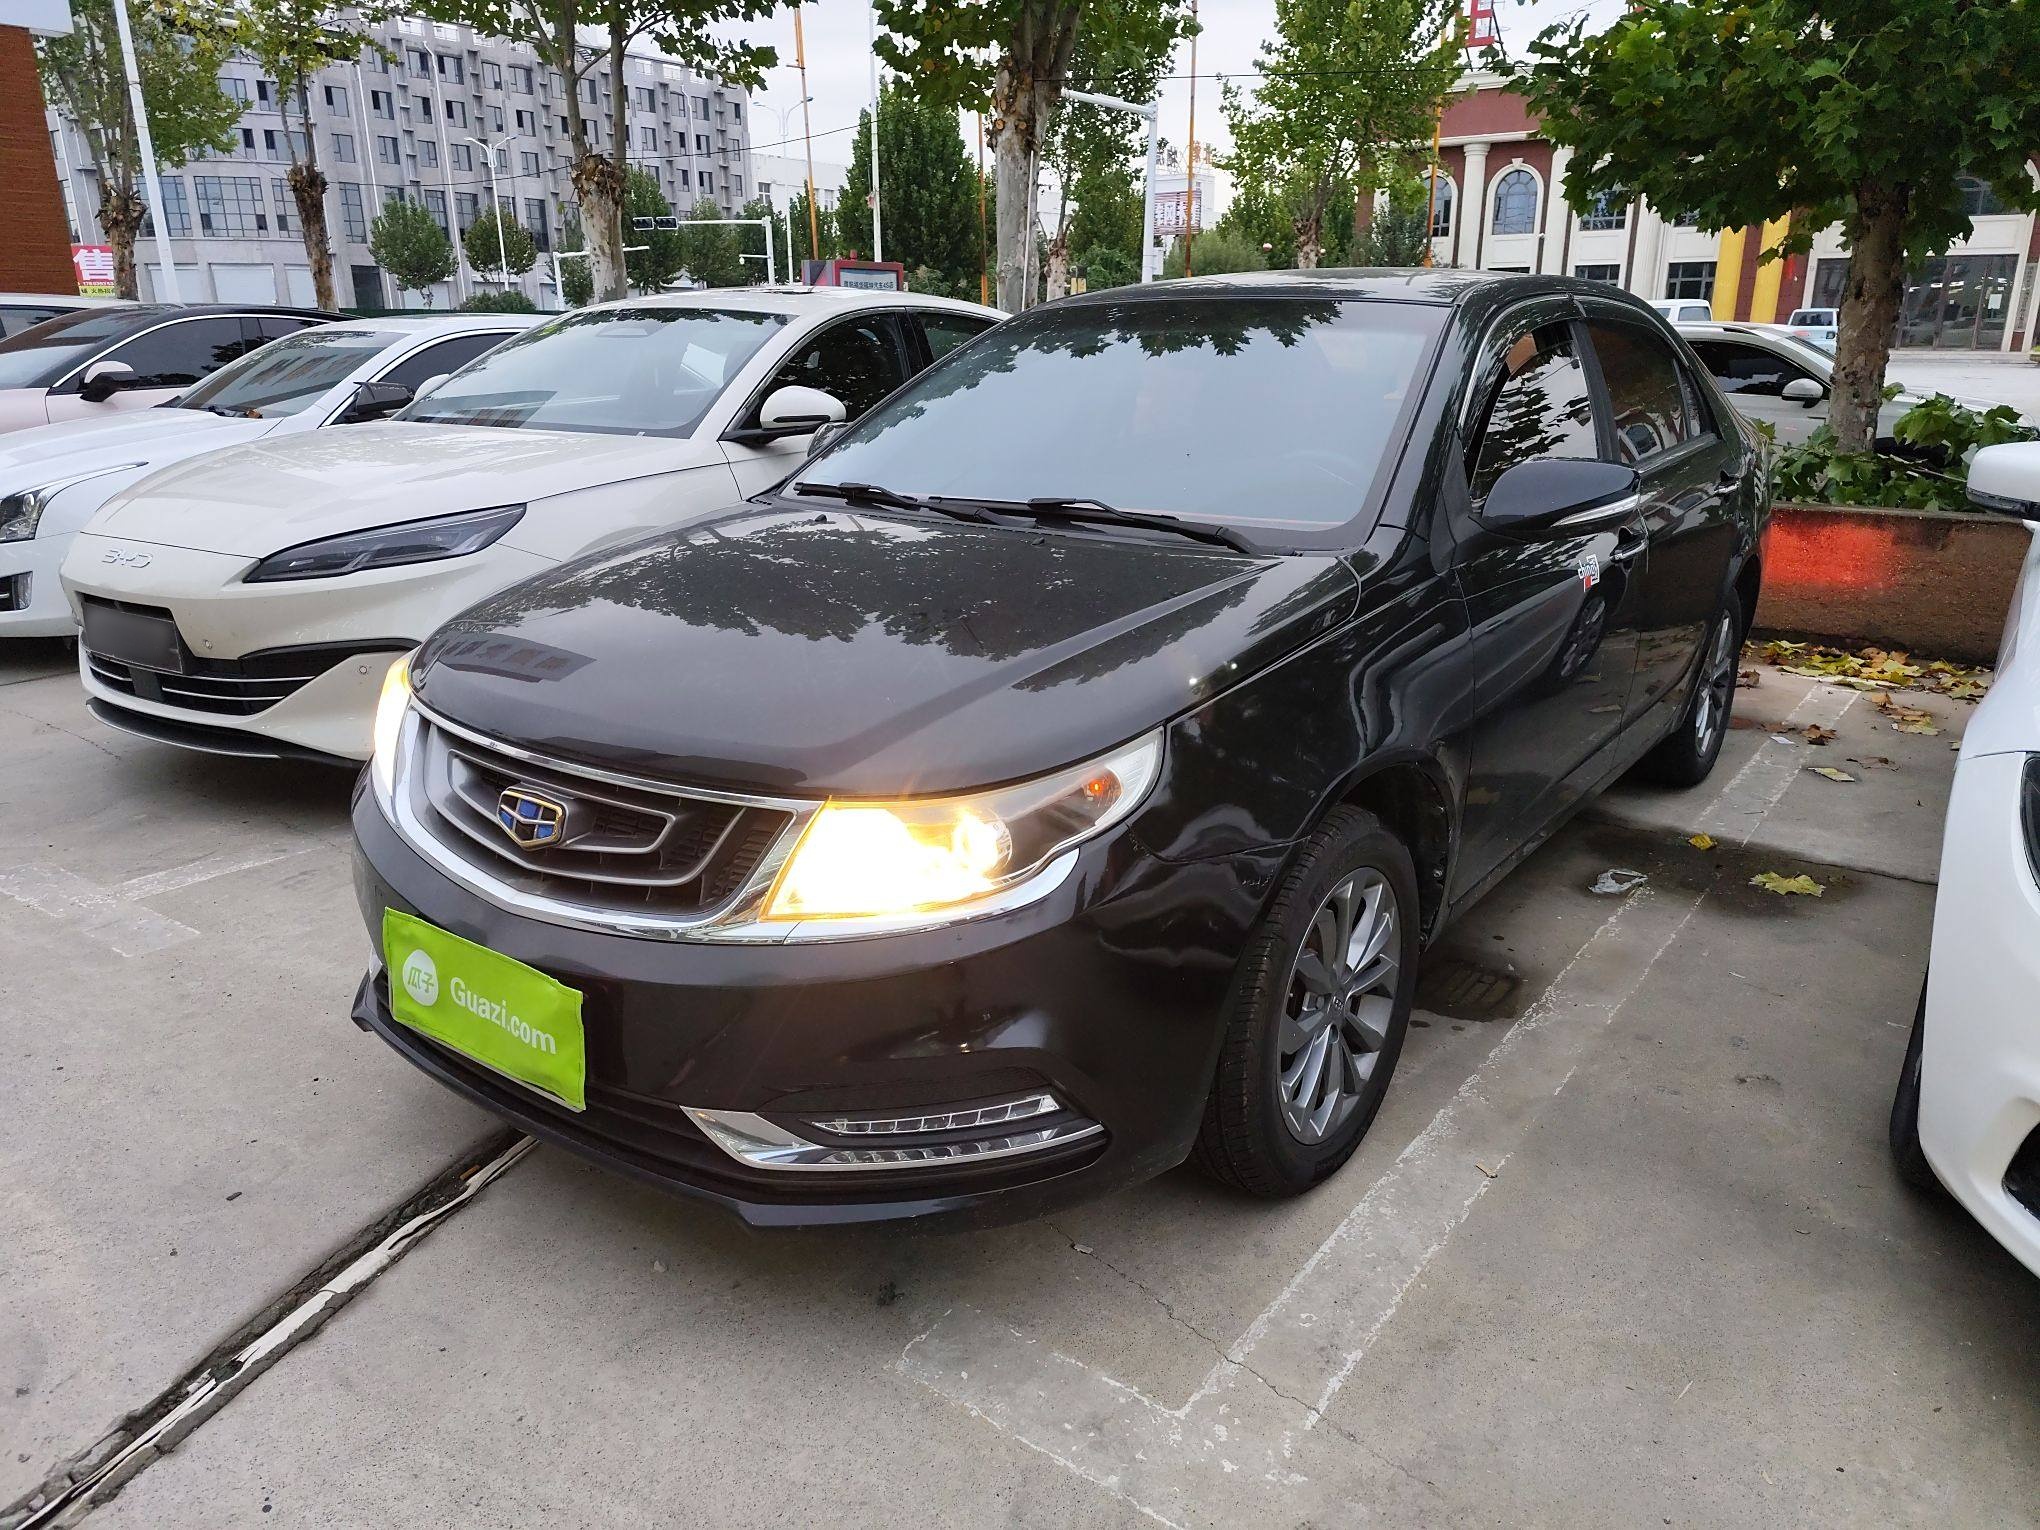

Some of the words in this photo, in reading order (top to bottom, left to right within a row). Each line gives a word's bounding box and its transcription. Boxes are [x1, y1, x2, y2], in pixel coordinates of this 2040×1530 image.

[73, 248, 115, 281] 售
[101, 547, 154, 570] BYD
[407, 966, 435, 994] 瓜子
[450, 976, 557, 1055] Guazi.com
